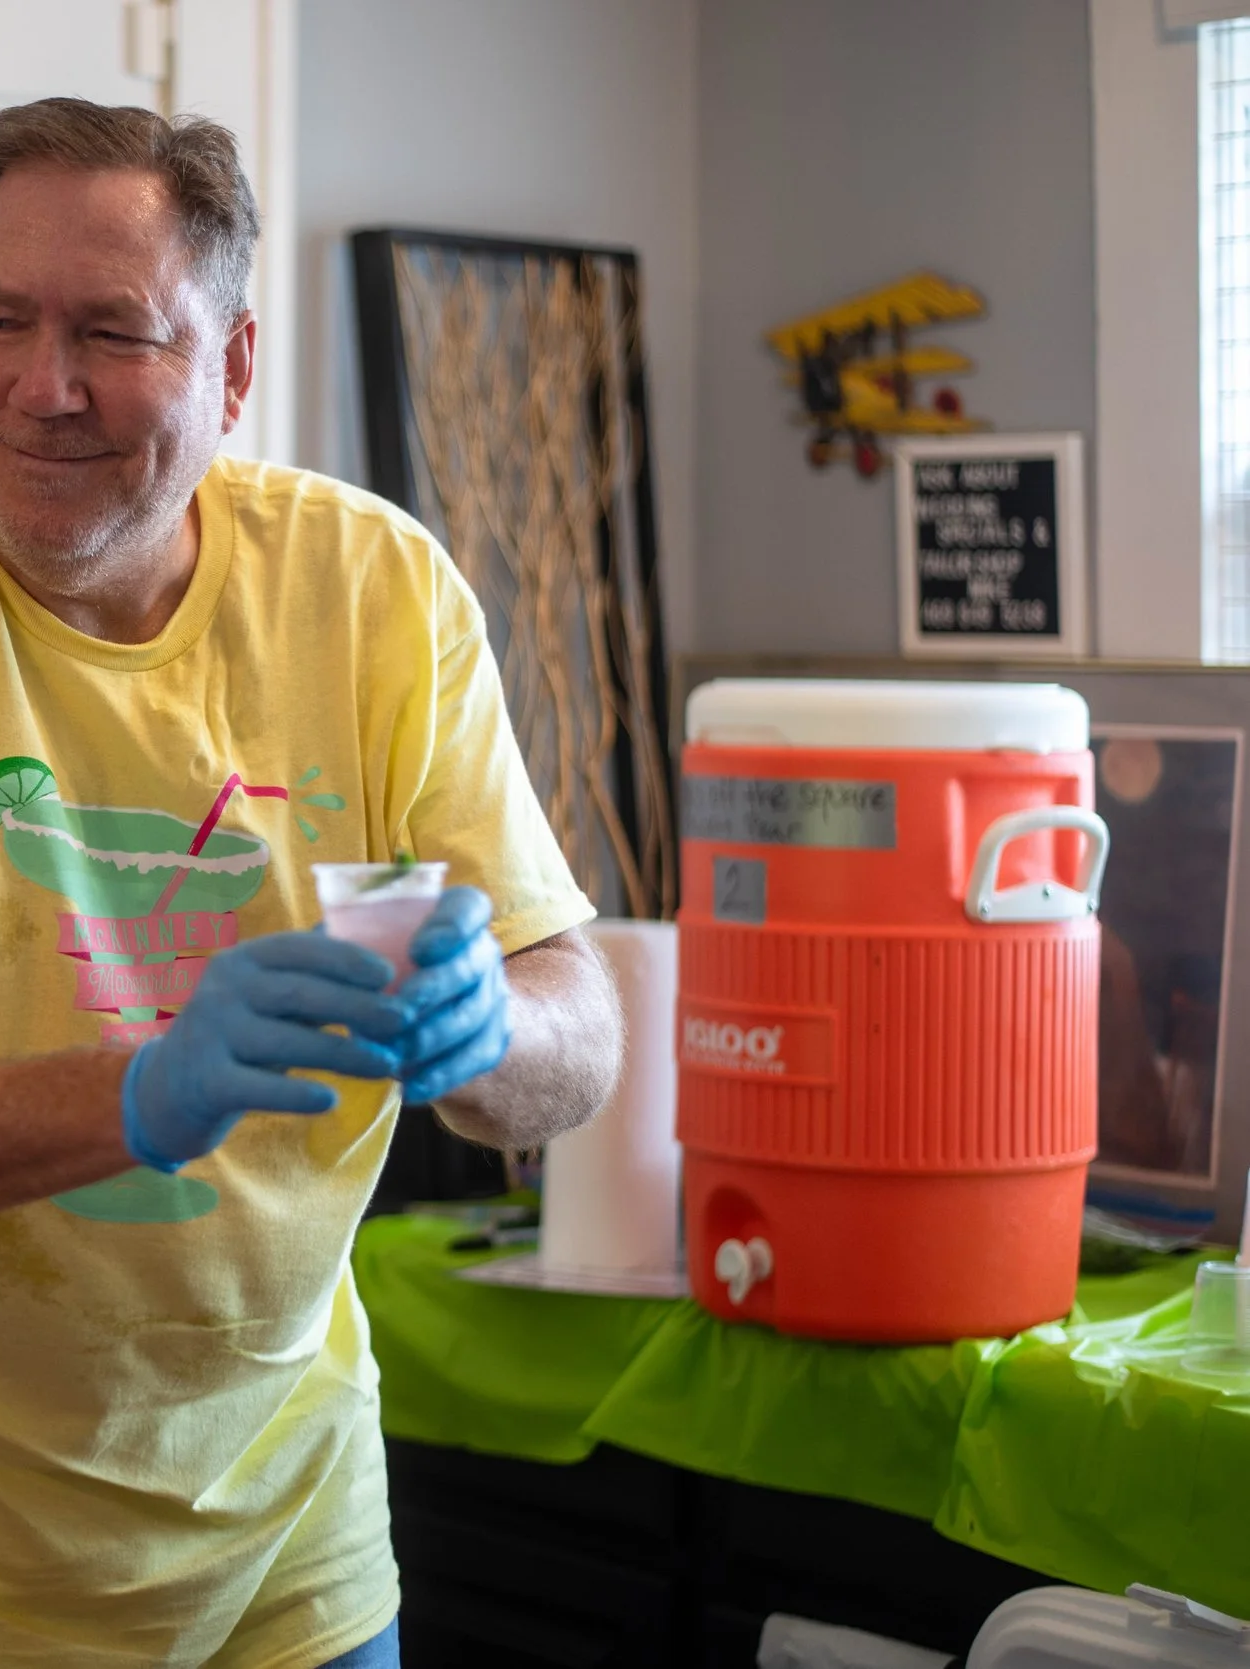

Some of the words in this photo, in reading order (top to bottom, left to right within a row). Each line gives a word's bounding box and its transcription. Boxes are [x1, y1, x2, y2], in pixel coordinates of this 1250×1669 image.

[721, 861, 750, 912] 2
[72, 915, 226, 952] McKINNEY
[87, 965, 193, 1006] Margarita
